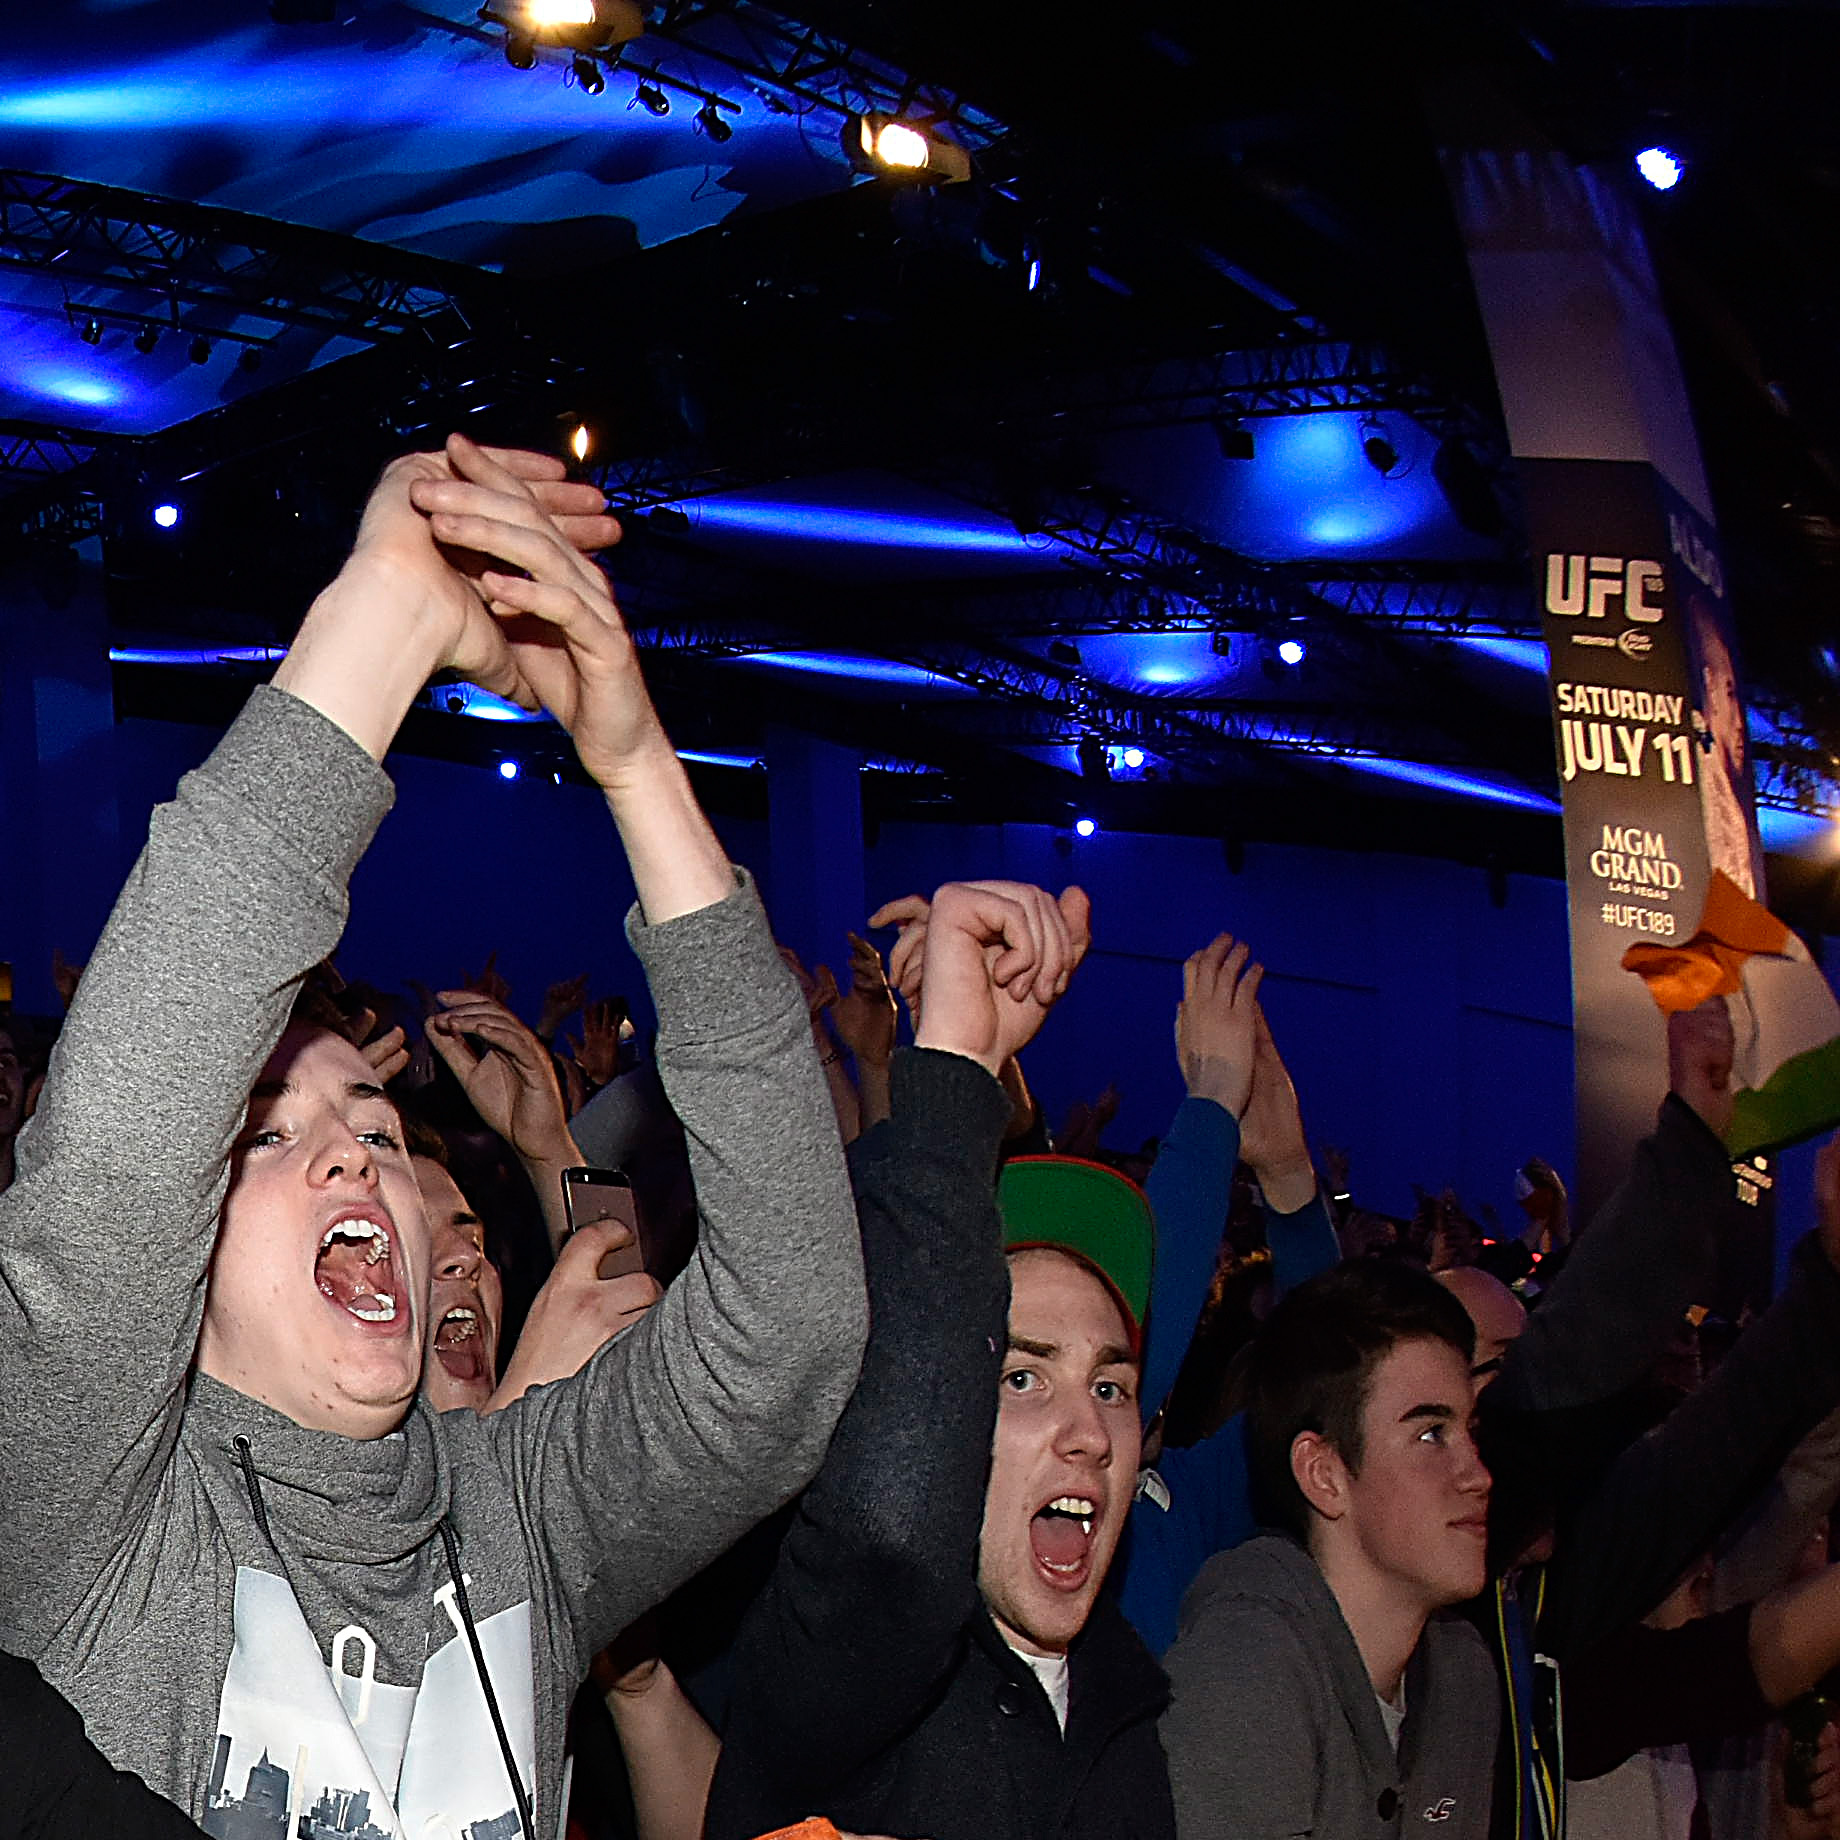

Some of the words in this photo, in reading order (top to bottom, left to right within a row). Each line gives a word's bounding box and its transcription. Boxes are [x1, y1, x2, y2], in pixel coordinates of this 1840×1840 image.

[1546, 553, 1664, 623] UFC
[1556, 683, 1684, 725] SATURDAY
[1561, 719, 1646, 782] JULY
[1652, 732, 1694, 785] 11
[1602, 824, 1667, 860] MGM
[1590, 850, 1683, 890] GRAND
[1608, 881, 1631, 895] LAS
[1633, 885, 1670, 901] VEGAS
[1601, 902, 1676, 936] #UFC189
